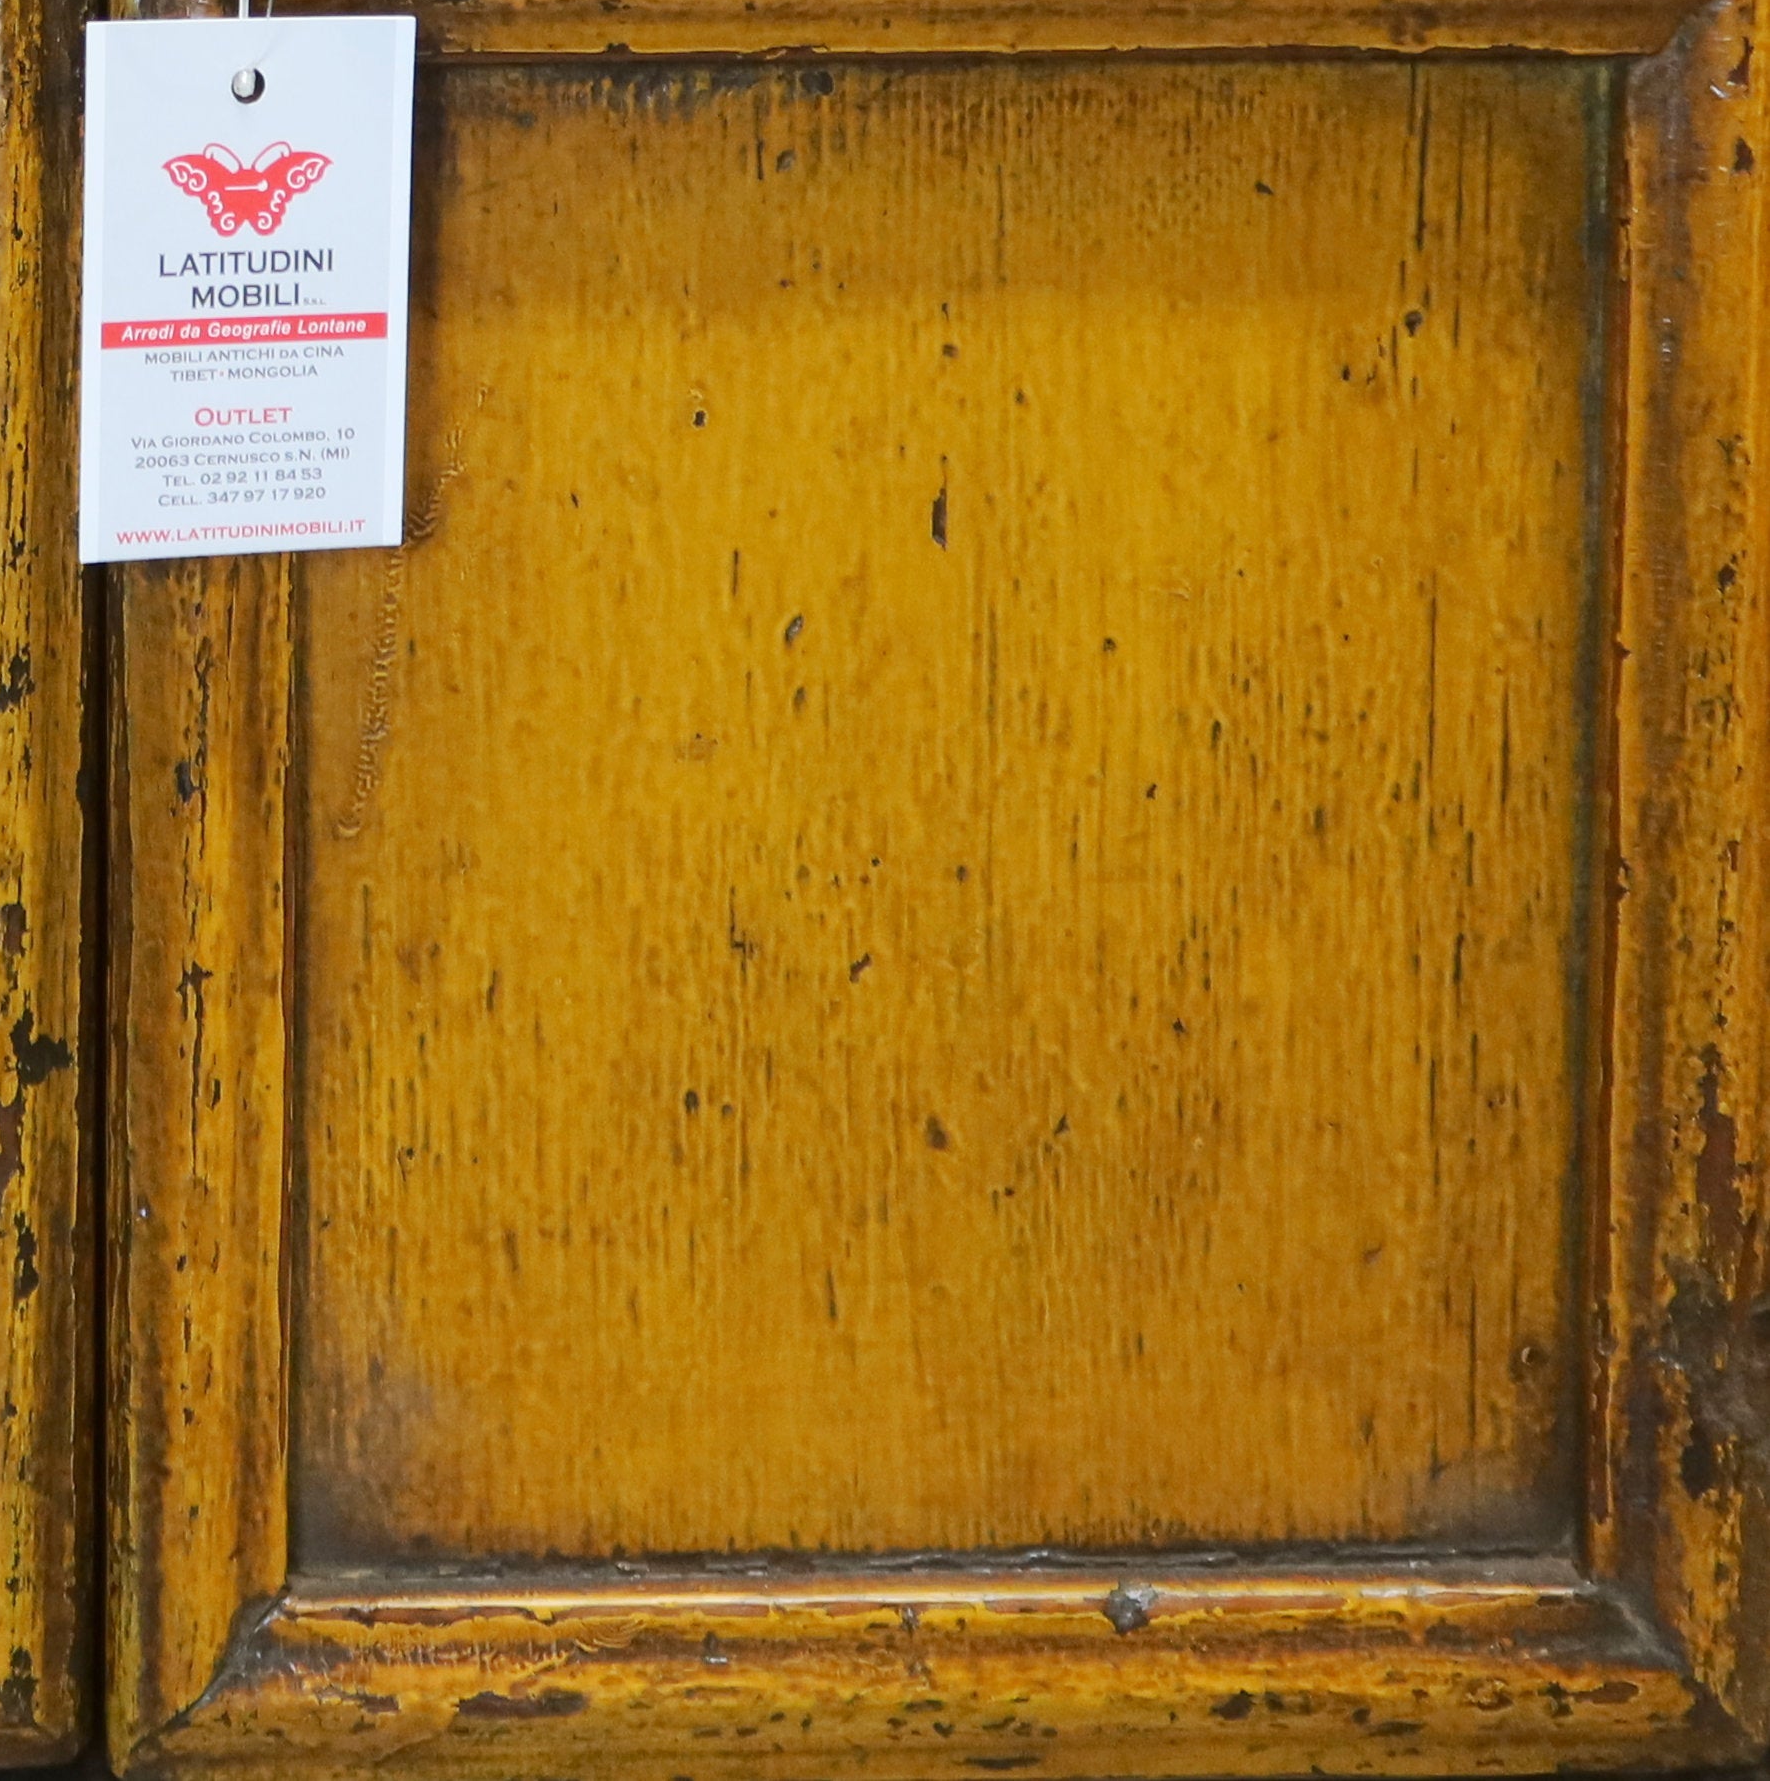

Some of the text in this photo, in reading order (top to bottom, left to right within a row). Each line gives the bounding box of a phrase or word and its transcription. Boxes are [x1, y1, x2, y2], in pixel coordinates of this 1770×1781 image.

[159, 249, 334, 277] LATITUDINI
[191, 283, 299, 309] MOBILI
[121, 319, 366, 342] Arredi da Geografie Lontane
[145, 351, 202, 365] MOBILI
[207, 348, 274, 362] ANTICHI
[303, 346, 344, 358] CINA
[170, 365, 318, 382] TIBET MONGOLIA
[337, 428, 355, 441] 10
[135, 454, 189, 469] 20063
[321, 448, 350, 462] (MI)
[200, 472, 222, 485] 02
[226, 471, 247, 484] 92
[254, 470, 268, 482] 11
[275, 469, 296, 481] 84
[302, 468, 322, 480] 53
[207, 491, 239, 504] 347
[244, 490, 266, 503] 97
[271, 488, 289, 501] 17
[293, 486, 326, 500] 920
[116, 519, 366, 545] WWW.LATITUDINIMOBILI.IT
